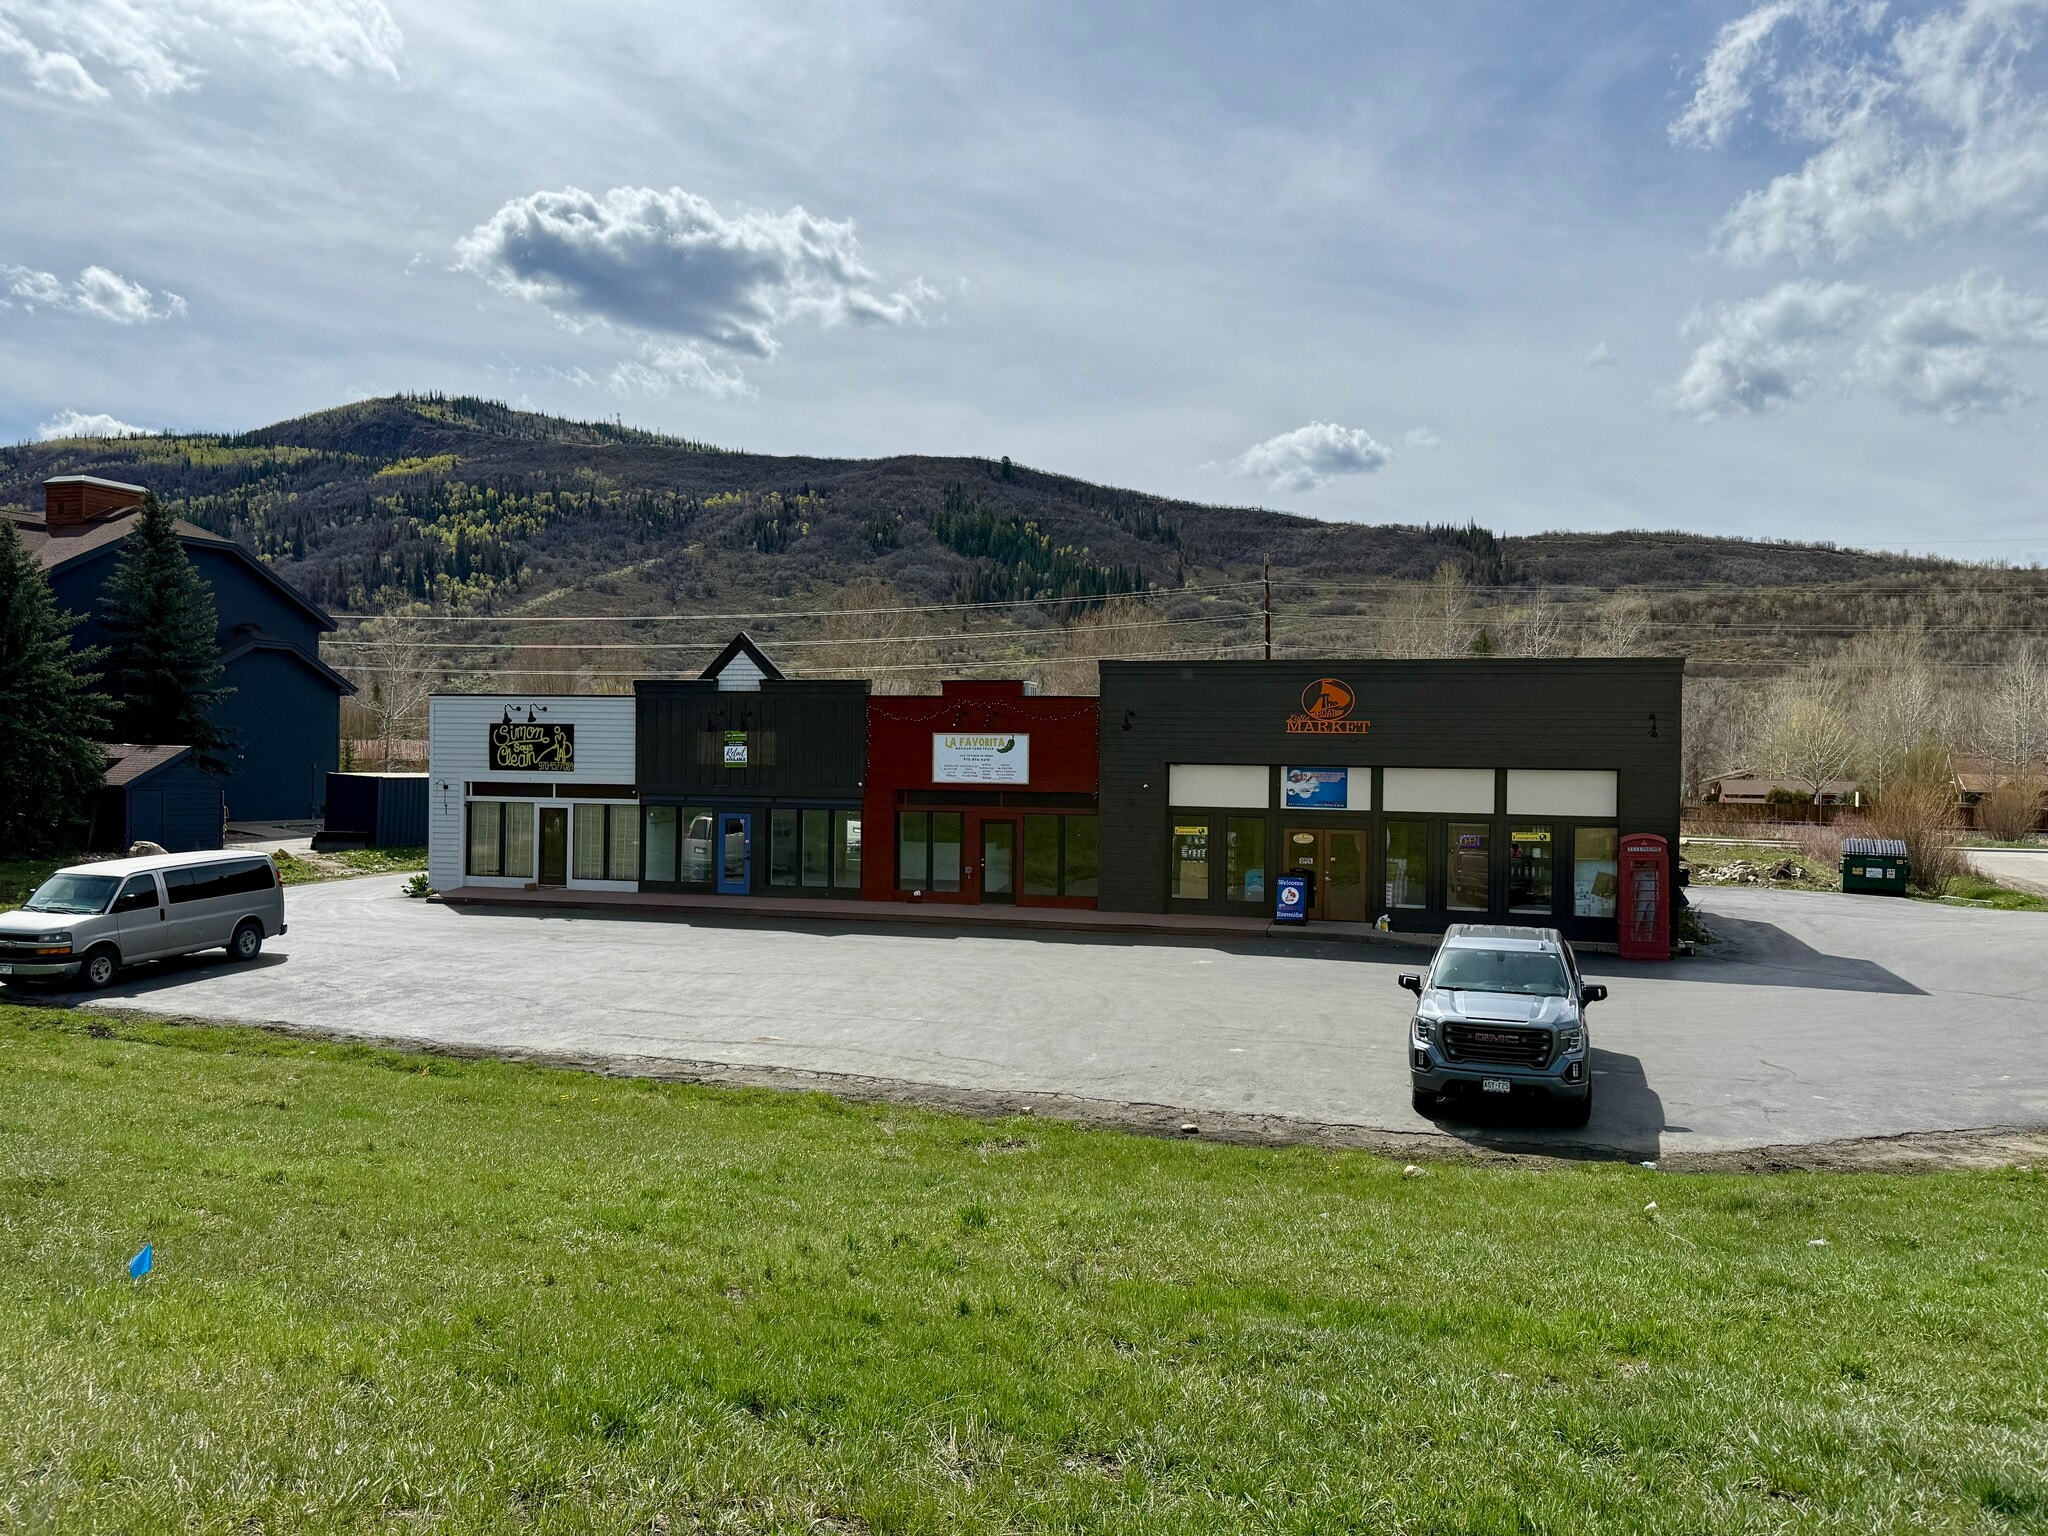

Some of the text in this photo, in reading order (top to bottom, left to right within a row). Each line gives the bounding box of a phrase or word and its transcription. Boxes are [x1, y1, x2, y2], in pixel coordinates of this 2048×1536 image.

[1320, 693, 1338, 708] The
[1316, 709, 1336, 718] BOAT
[1286, 720, 1371, 734] MARKET
[494, 725, 546, 746] Simon
[513, 742, 534, 754] Says
[944, 737, 1005, 748] LA FAVORITA
[497, 745, 541, 768] Clean
[1459, 835, 1479, 846] OPEN
[1474, 1032, 1519, 1044] GMC
